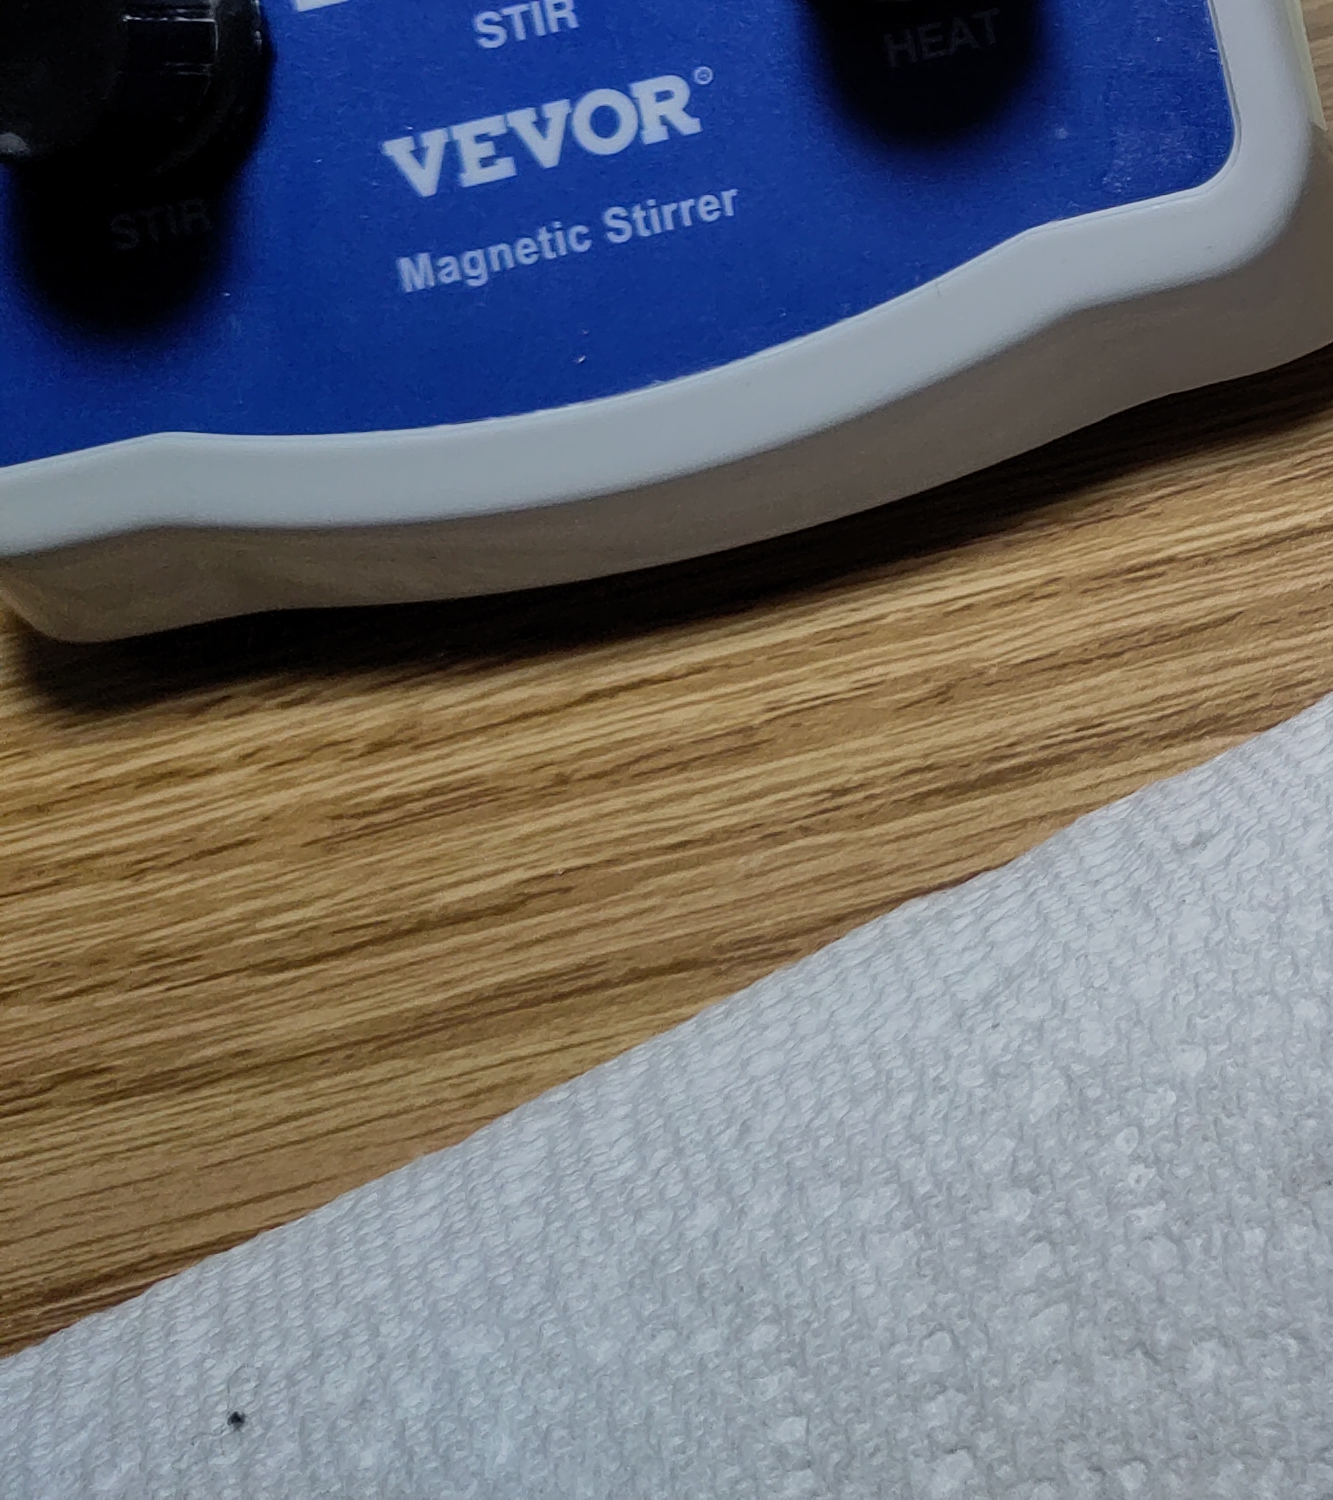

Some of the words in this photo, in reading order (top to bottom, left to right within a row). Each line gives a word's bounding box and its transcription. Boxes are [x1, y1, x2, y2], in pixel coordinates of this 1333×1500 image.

[883, 7, 1001, 68] HEAT
[381, 75, 702, 198] VEVOR
[397, 224, 592, 293] Magnetic
[603, 189, 739, 245] Stirrer
